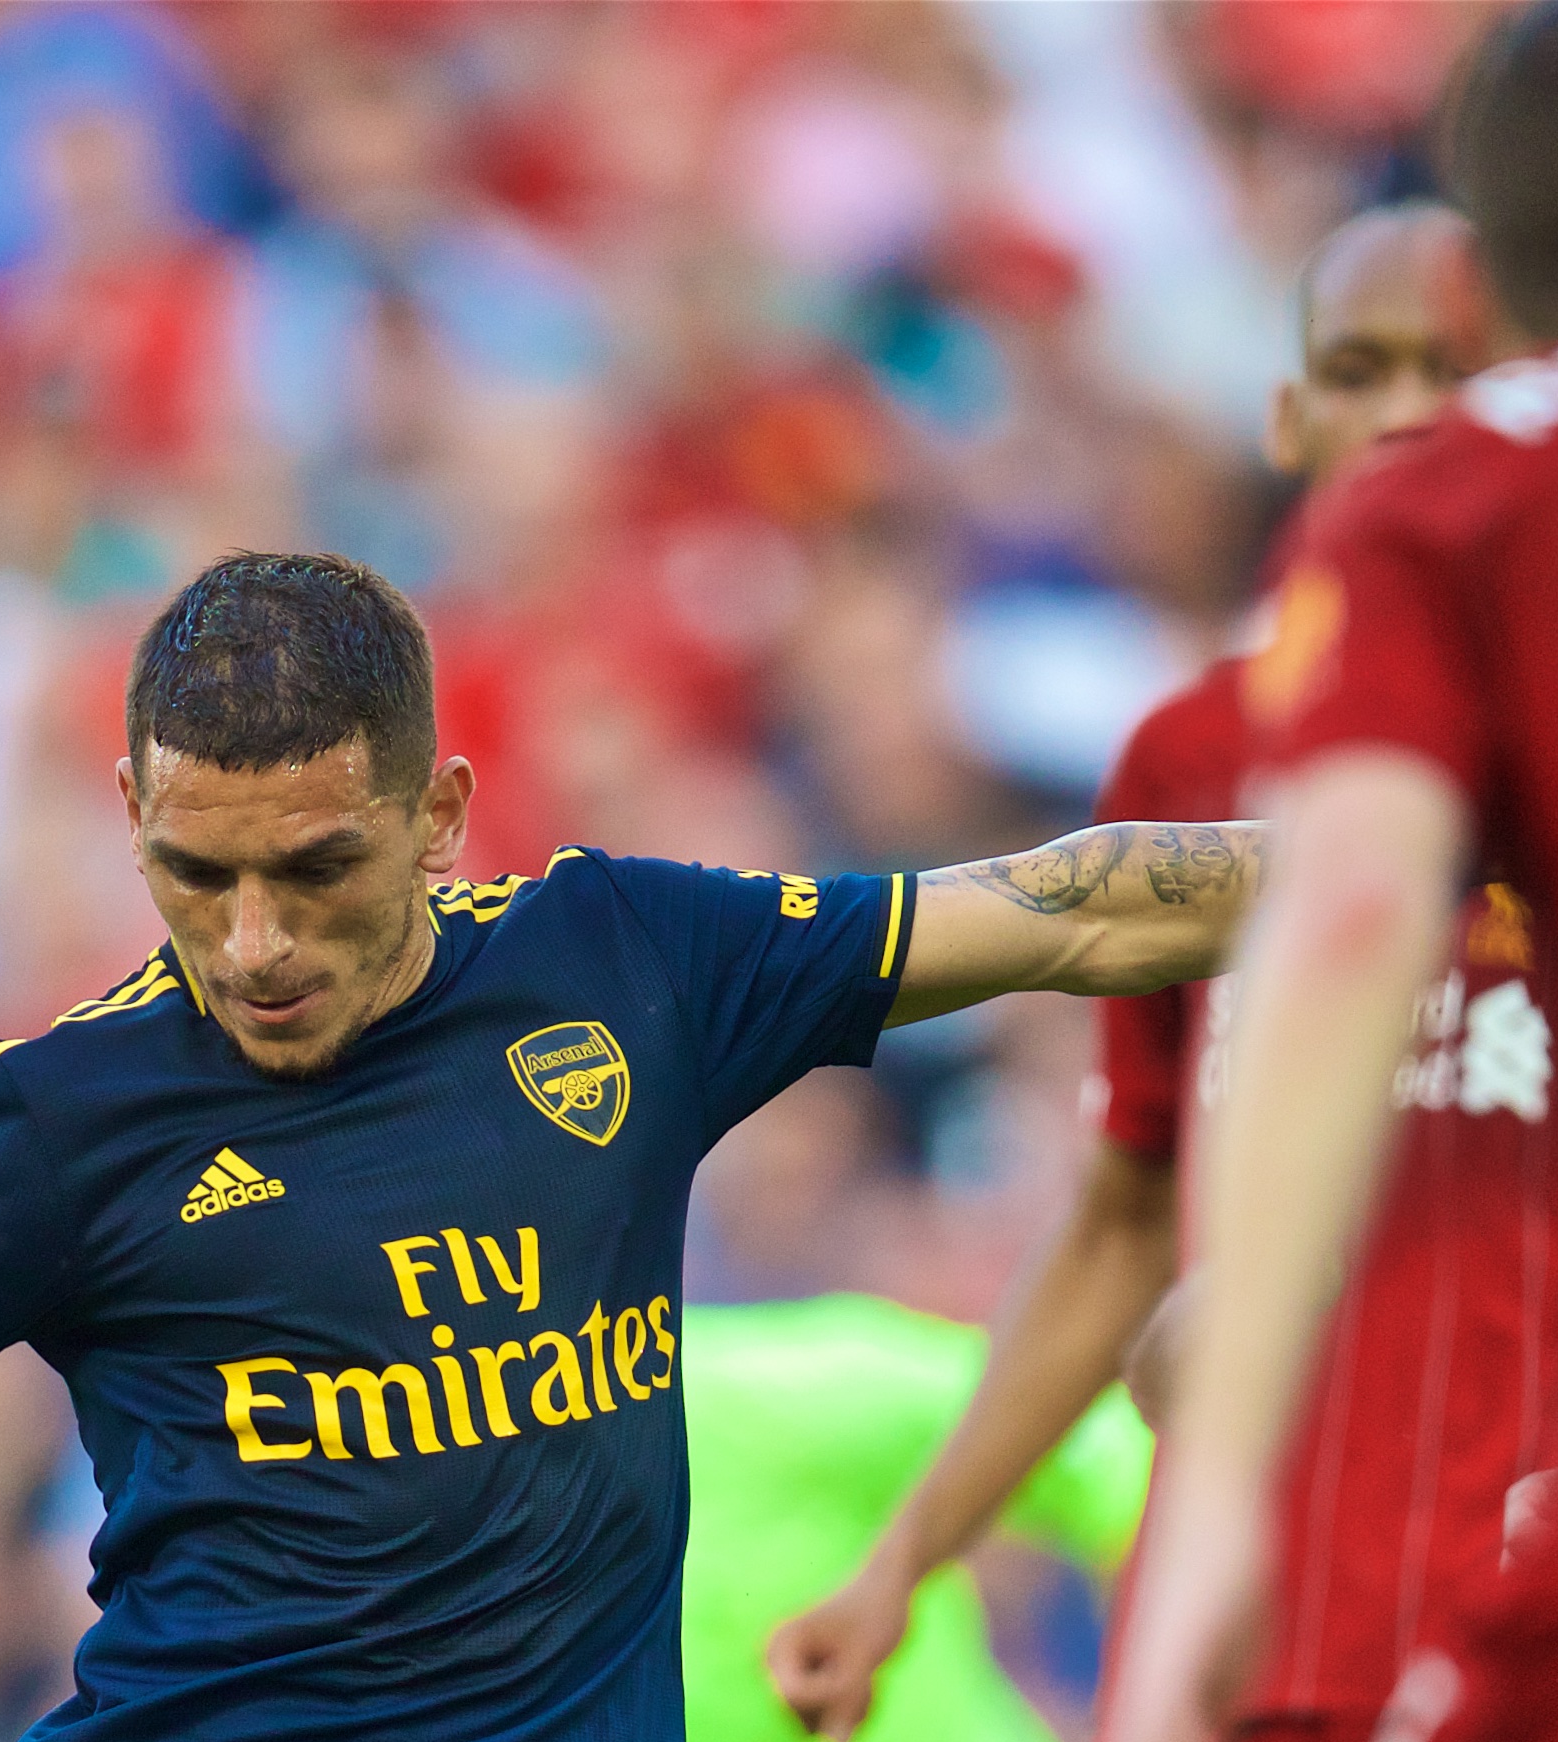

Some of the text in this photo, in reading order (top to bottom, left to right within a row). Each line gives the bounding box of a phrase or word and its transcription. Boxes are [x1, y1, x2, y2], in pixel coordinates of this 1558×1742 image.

[528, 1036, 605, 1074] Arsenal
[181, 1175, 286, 1223] adidas
[380, 1227, 540, 1317] Fly
[216, 1295, 676, 1462] Emirates
